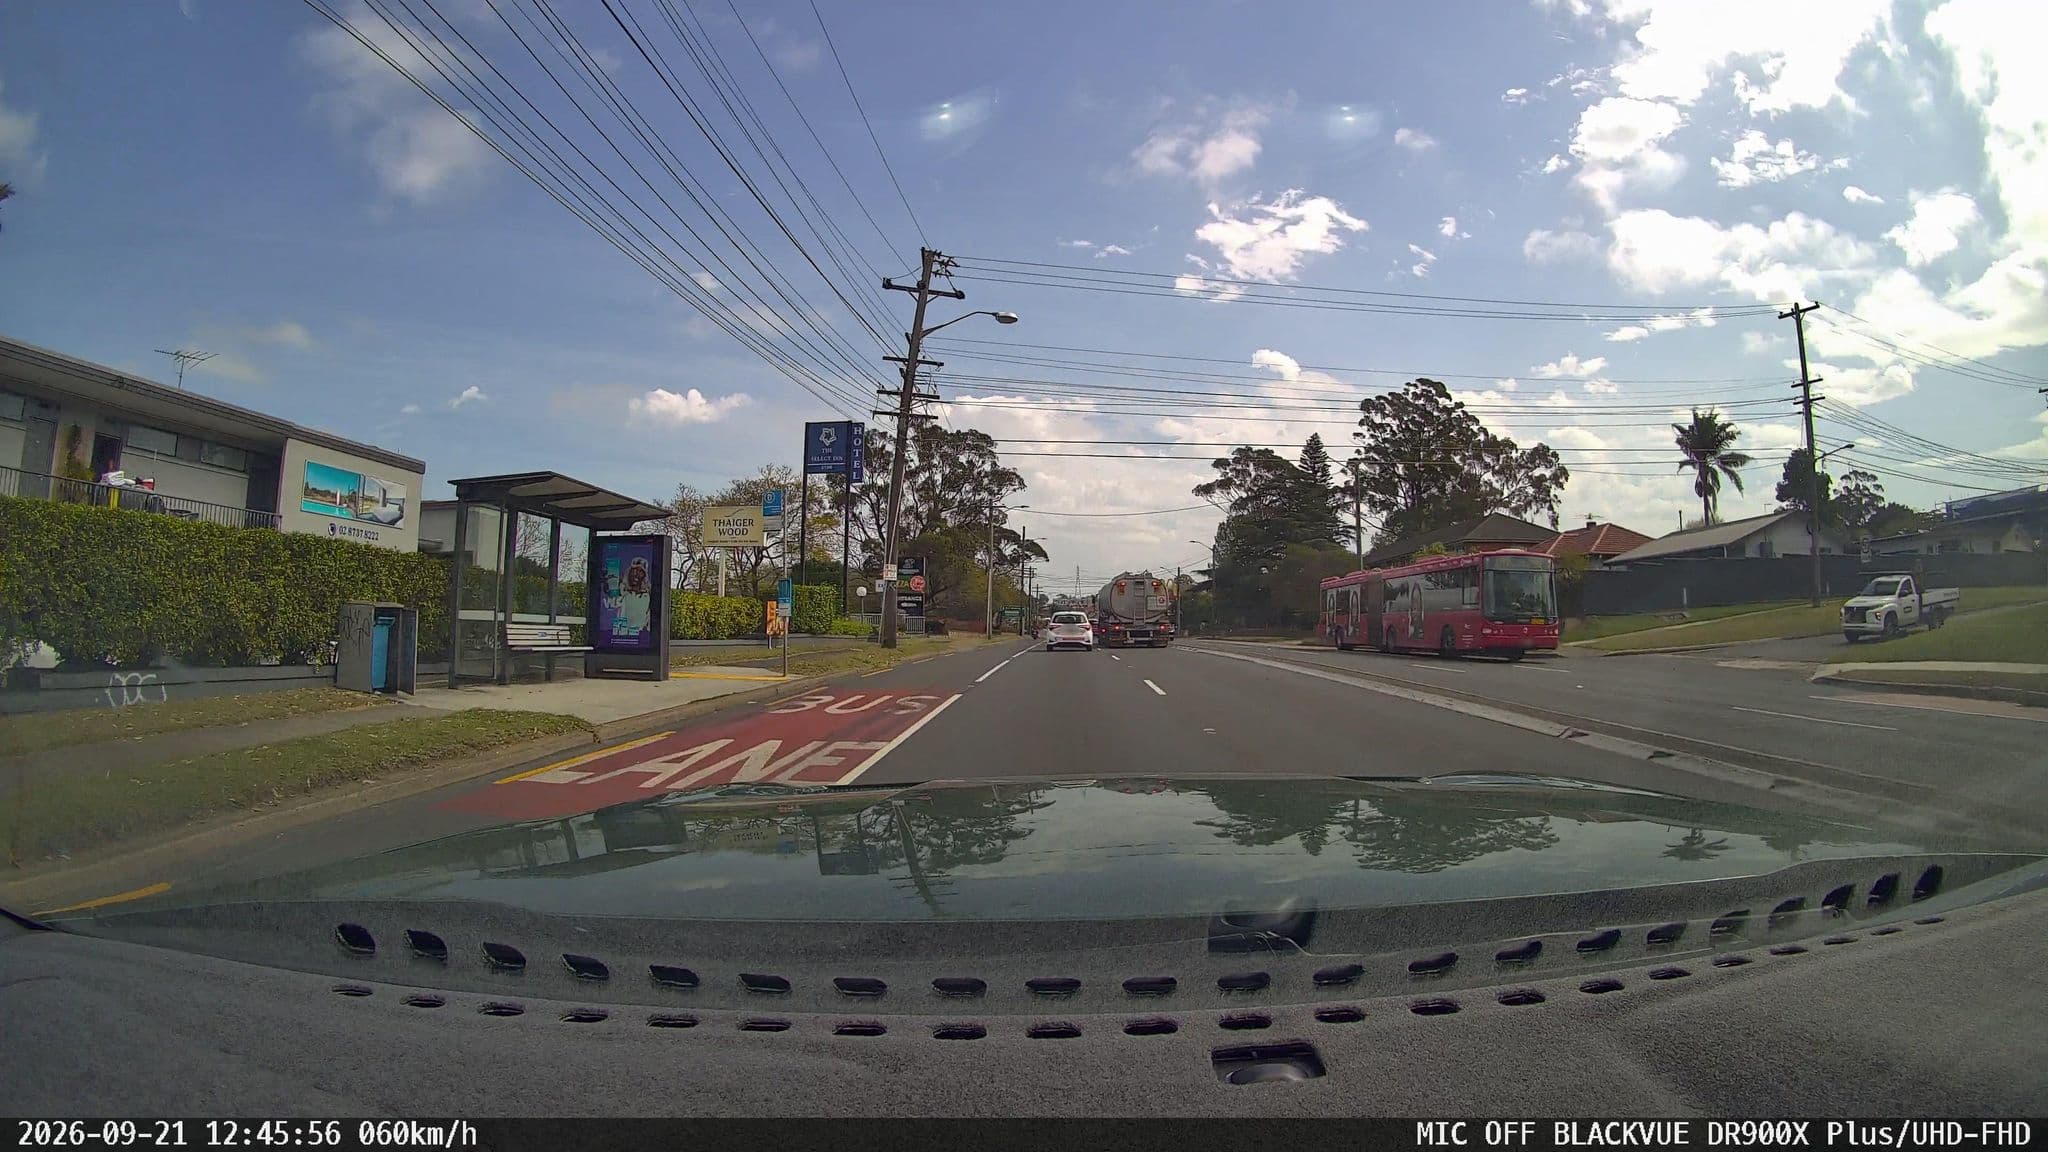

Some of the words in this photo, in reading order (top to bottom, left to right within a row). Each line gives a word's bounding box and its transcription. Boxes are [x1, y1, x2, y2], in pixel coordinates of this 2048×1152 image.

[853, 426, 863, 480] HOTEL
[713, 518, 754, 527] THAIGER
[718, 527, 749, 536] WOOD
[767, 695, 940, 715] BUS
[518, 738, 889, 789] LANE
